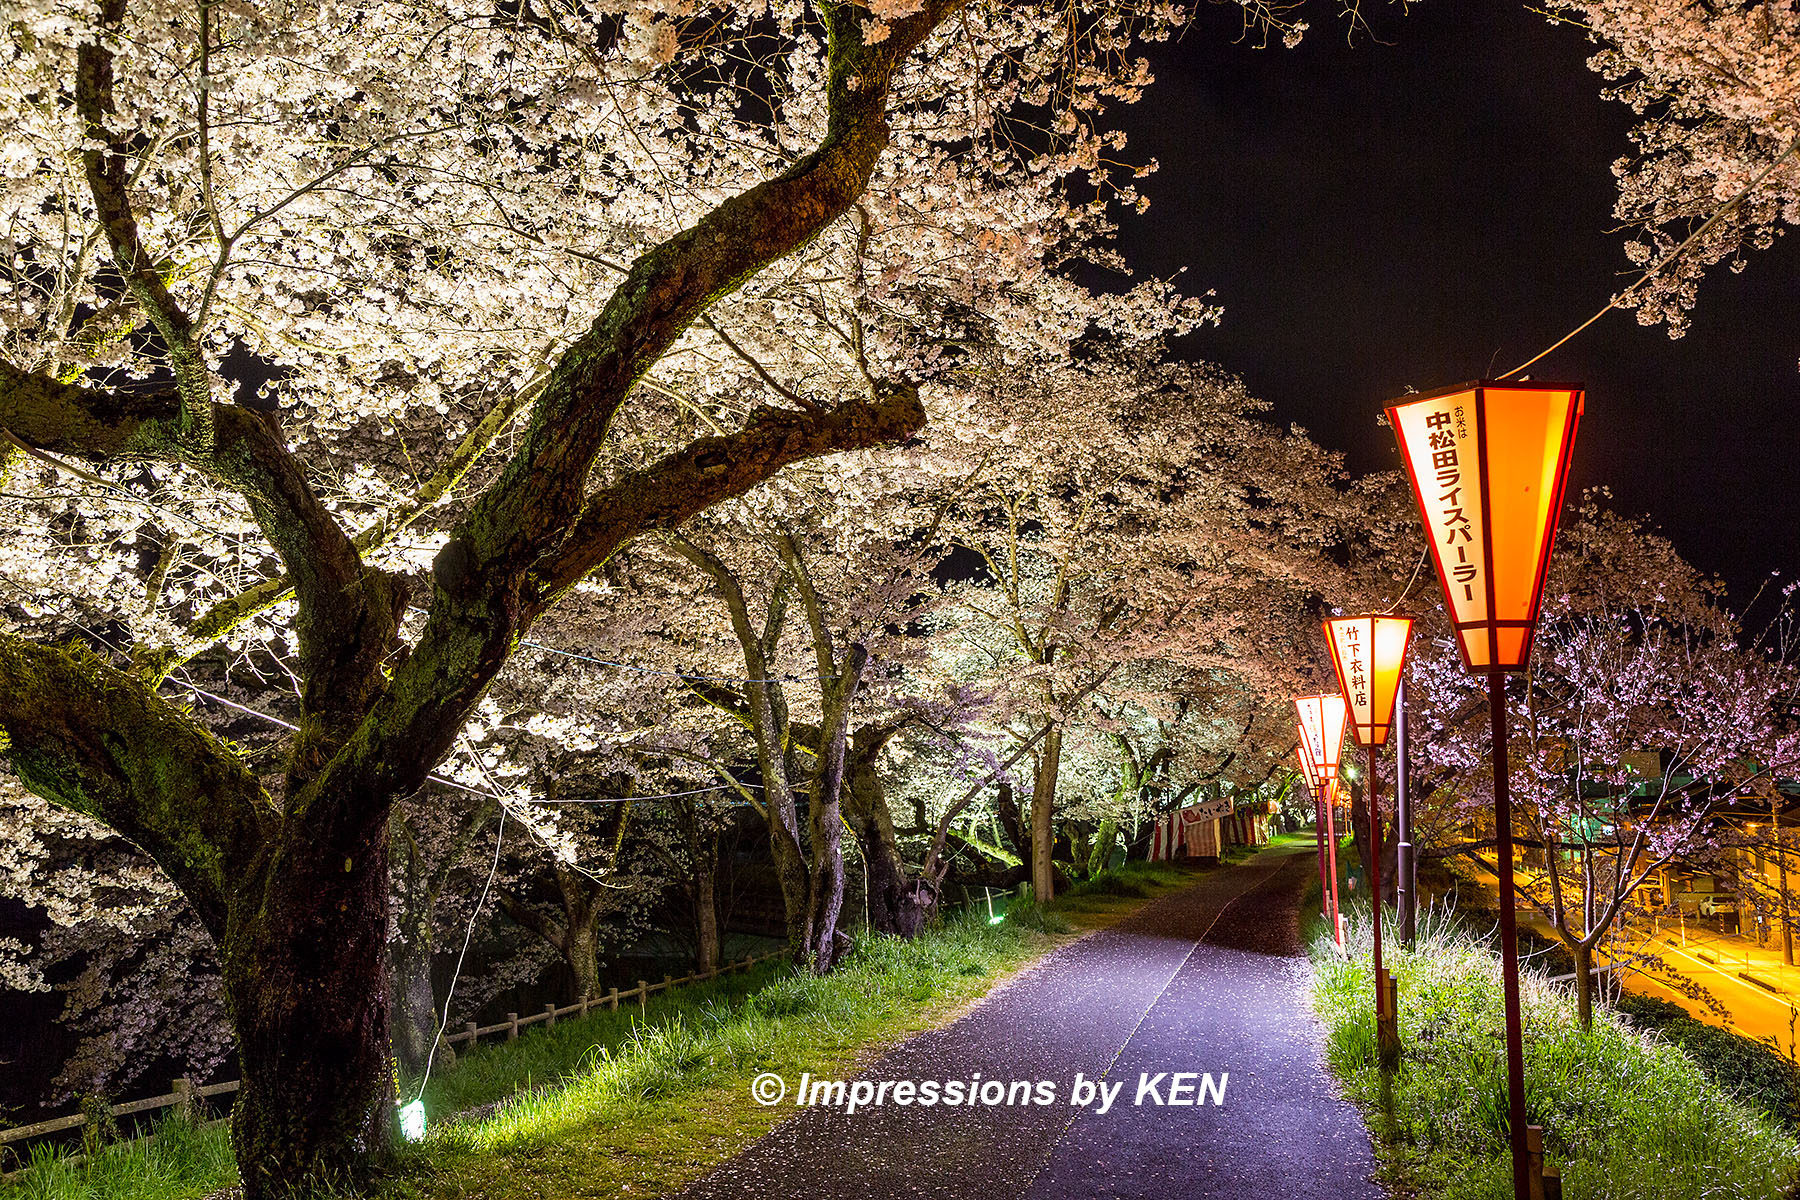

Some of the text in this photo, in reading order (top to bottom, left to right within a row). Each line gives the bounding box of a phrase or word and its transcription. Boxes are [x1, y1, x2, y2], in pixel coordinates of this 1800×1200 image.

[1454, 405, 1468, 440] お米は
[1425, 411, 1477, 602] 中松田ライスパーラー
[1345, 625, 1367, 707] 竹下衣料店
